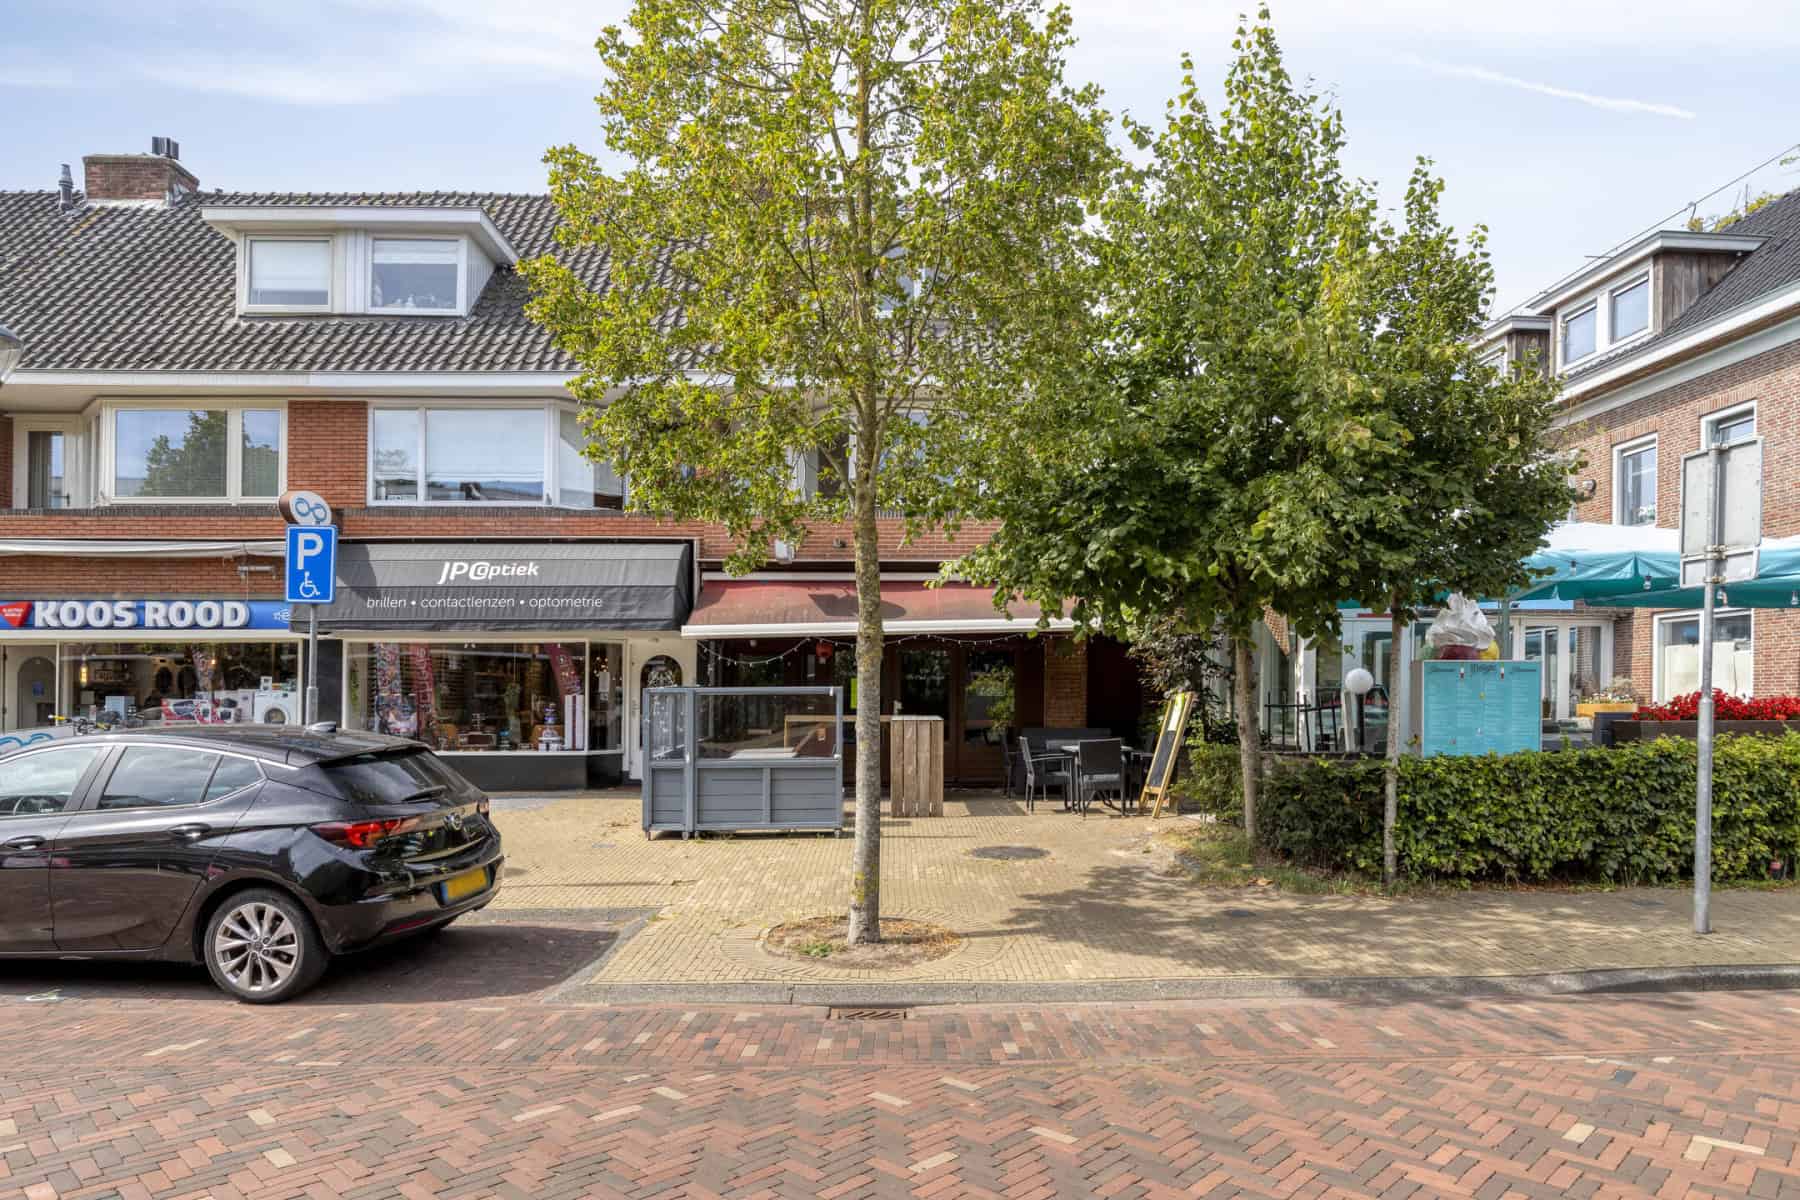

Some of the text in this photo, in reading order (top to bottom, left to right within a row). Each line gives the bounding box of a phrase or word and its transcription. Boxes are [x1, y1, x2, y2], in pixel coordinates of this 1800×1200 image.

[297, 532, 324, 570] P
[34, 601, 138, 628] KOOS
[144, 601, 249, 628] ROOD
[366, 596, 603, 609] brillen contactlenzen optometrie
